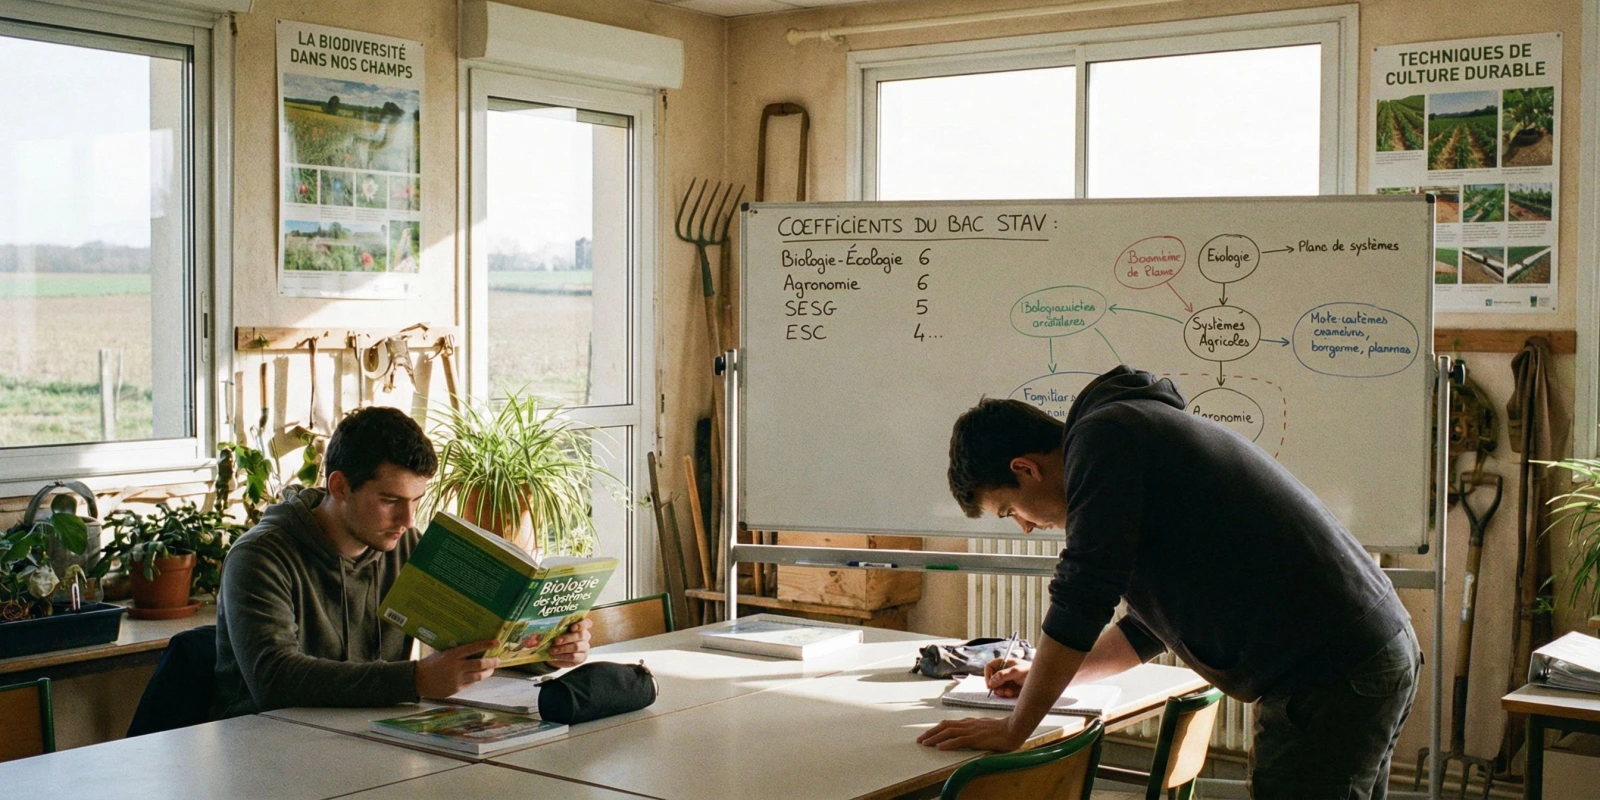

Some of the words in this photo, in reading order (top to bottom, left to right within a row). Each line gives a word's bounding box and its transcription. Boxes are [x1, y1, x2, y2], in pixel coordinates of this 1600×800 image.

[298, 31, 316, 47] LA
[319, 33, 406, 60] BIODIVERSITÉ
[1399, 45, 1504, 66] TECHNIQUES
[1509, 43, 1532, 59] DE
[290, 48, 327, 66] DANS
[331, 54, 357, 71] NOS
[360, 59, 413, 79] CHAMPS
[1386, 67, 1460, 85] CULTURE
[1465, 61, 1546, 80] DURABLE
[914, 217, 937, 233] DU
[947, 215, 984, 232] BAC
[996, 214, 1047, 232] STAV
[1332, 239, 1345, 251] de
[1350, 238, 1400, 257] systèmes
[781, 243, 904, 275] Biologie-Écologie
[918, 248, 931, 266] 6
[1127, 266, 1139, 278] de
[783, 274, 861, 299] Agronomie
[917, 274, 930, 291] 6
[785, 300, 838, 317] SESG
[916, 299, 928, 315] 5
[786, 324, 827, 340] ESC
[1192, 316, 1246, 339] Systèmes
[1199, 332, 1250, 353] Agricoles
[540, 576, 600, 594] Biologie
[533, 595, 551, 607] des
